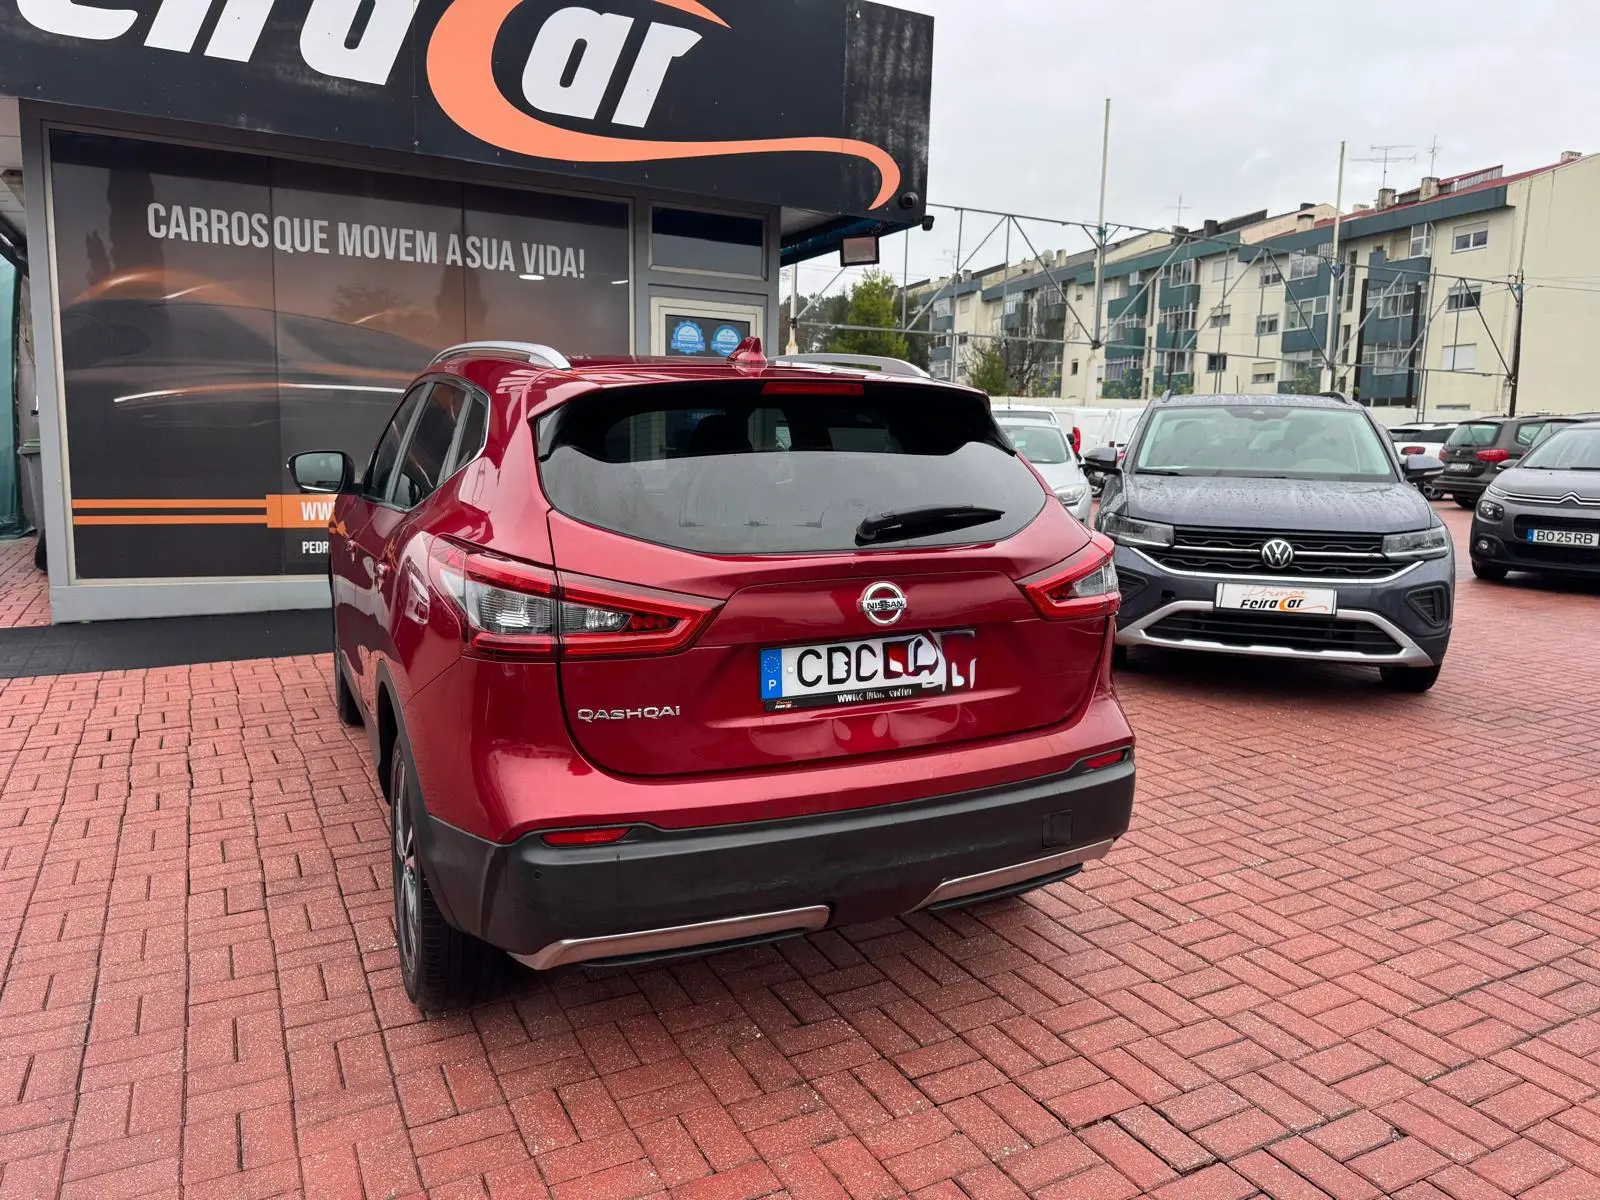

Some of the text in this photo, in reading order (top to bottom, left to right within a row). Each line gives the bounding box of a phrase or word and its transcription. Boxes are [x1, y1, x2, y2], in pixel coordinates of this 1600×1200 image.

[147, 201, 269, 249] CARROS
[274, 216, 330, 254] QUE
[338, 223, 437, 266] MOVEM
[522, 241, 586, 279] VIDA!
[866, 600, 904, 609] NISSAN
[768, 679, 777, 691] P
